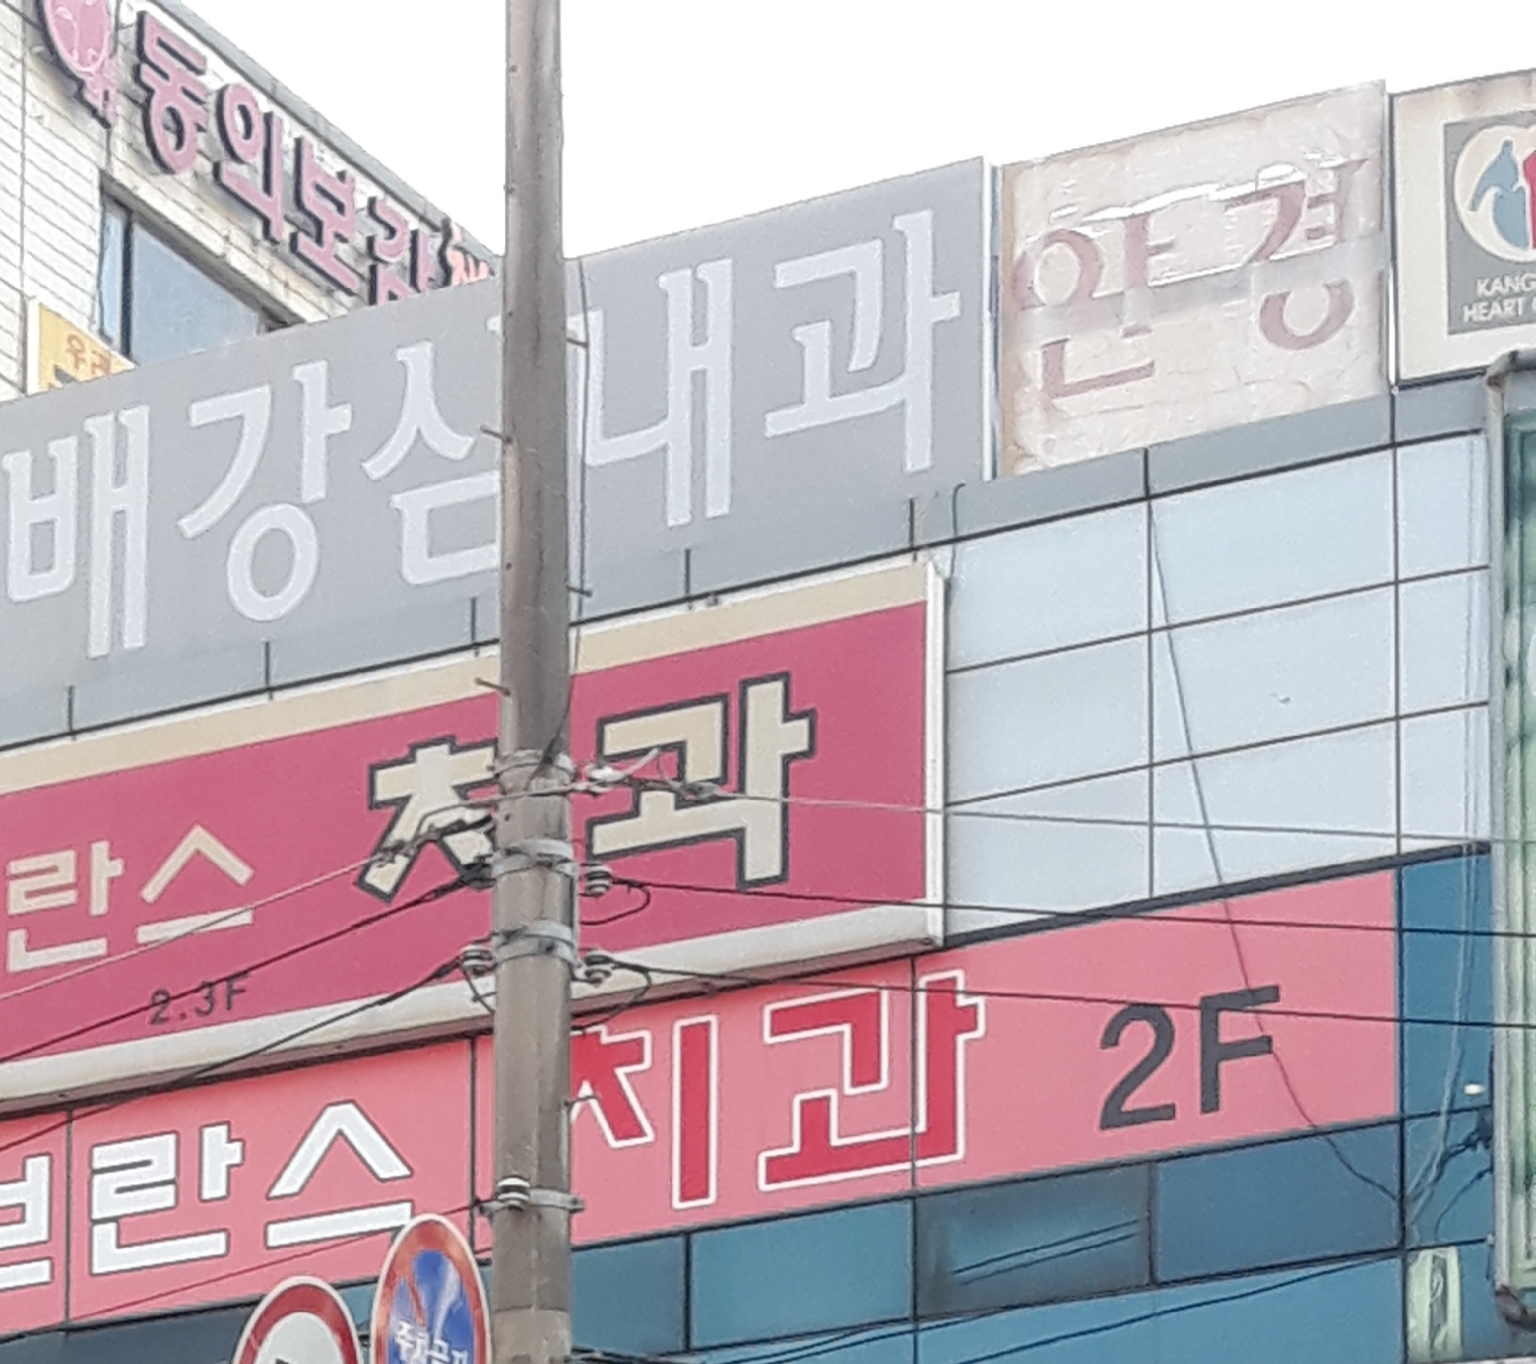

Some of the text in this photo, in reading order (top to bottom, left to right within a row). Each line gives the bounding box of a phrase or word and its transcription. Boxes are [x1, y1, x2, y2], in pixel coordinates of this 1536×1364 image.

[1463, 297, 1525, 324] HEART
[150, 972, 250, 1026] 2.3F
[1098, 984, 1282, 1134] 2F
